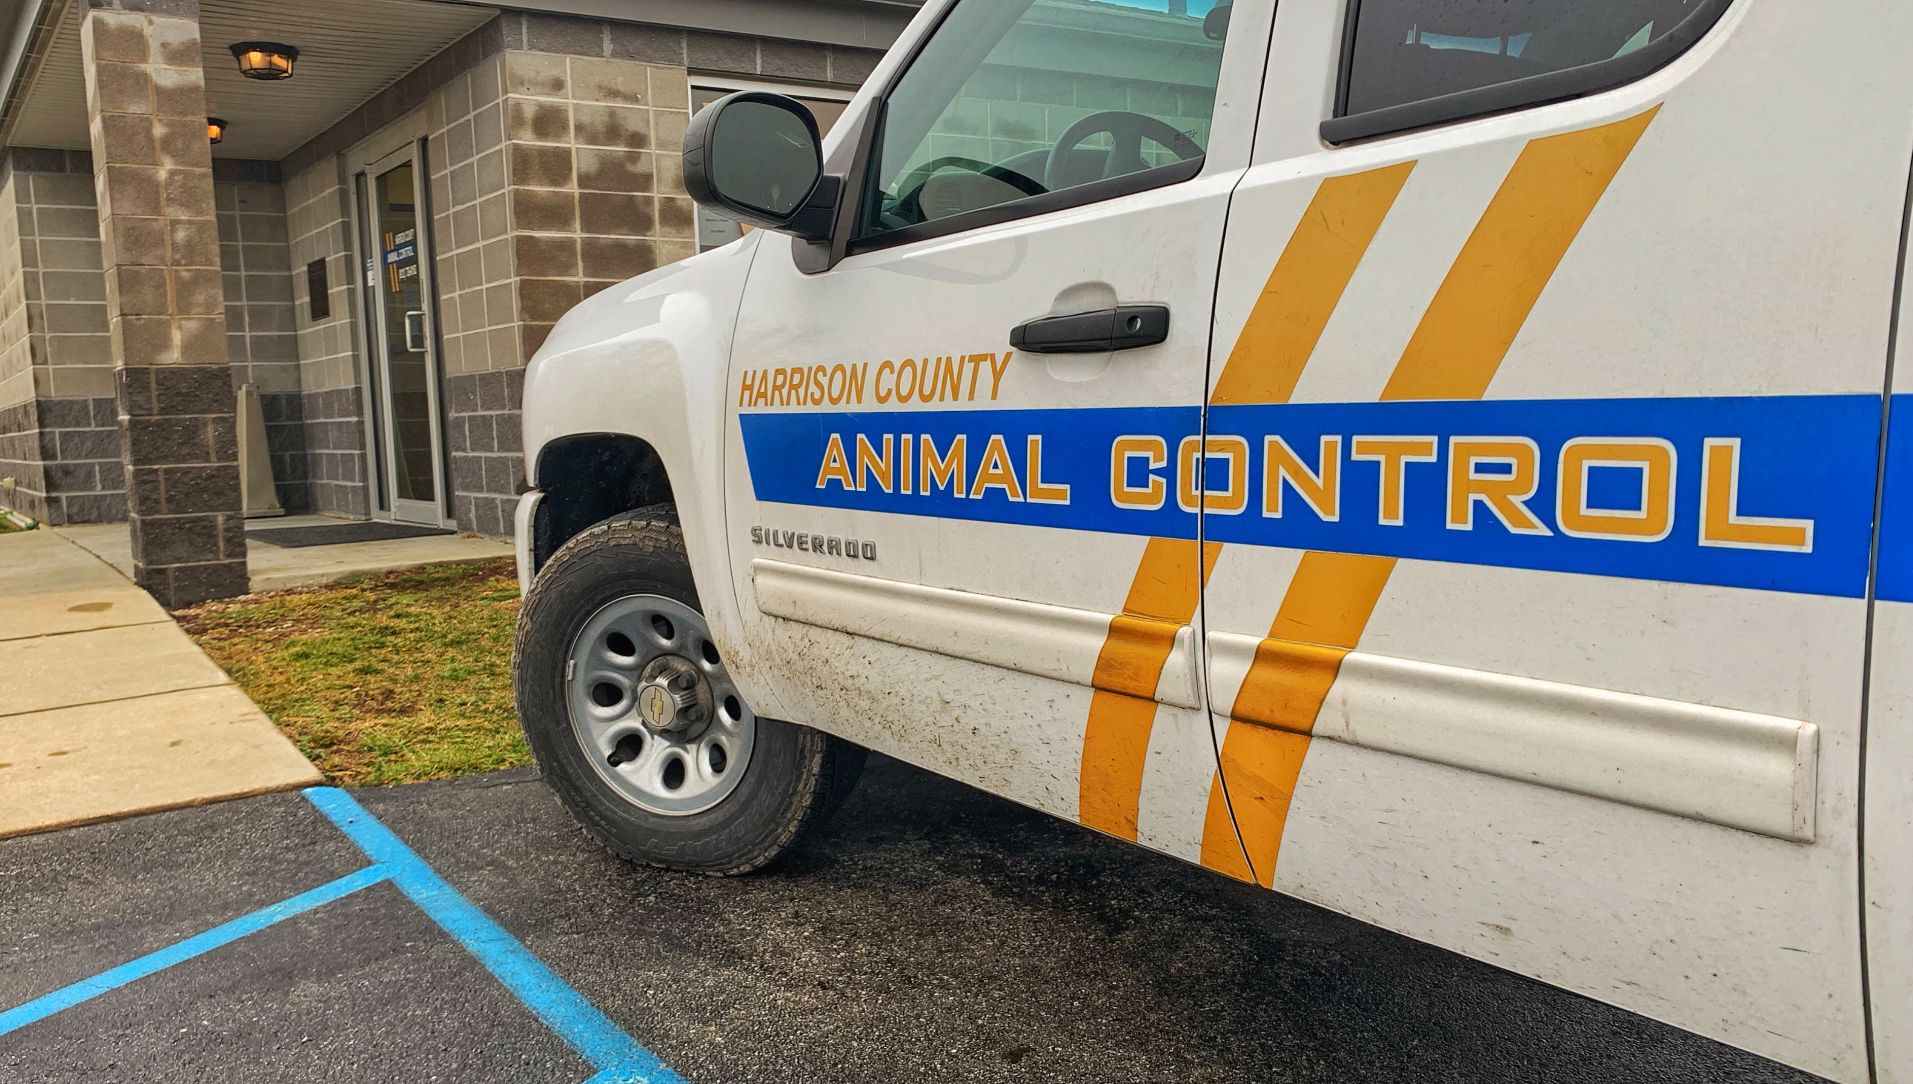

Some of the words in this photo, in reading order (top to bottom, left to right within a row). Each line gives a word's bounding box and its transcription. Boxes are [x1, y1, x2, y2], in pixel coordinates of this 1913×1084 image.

[739, 362, 868, 407] HARRISON
[875, 351, 1013, 404] COUNTY
[815, 433, 1070, 505] ANIMAL
[1111, 434, 1814, 554] CONTROL
[751, 526, 877, 561] SILVERADO
